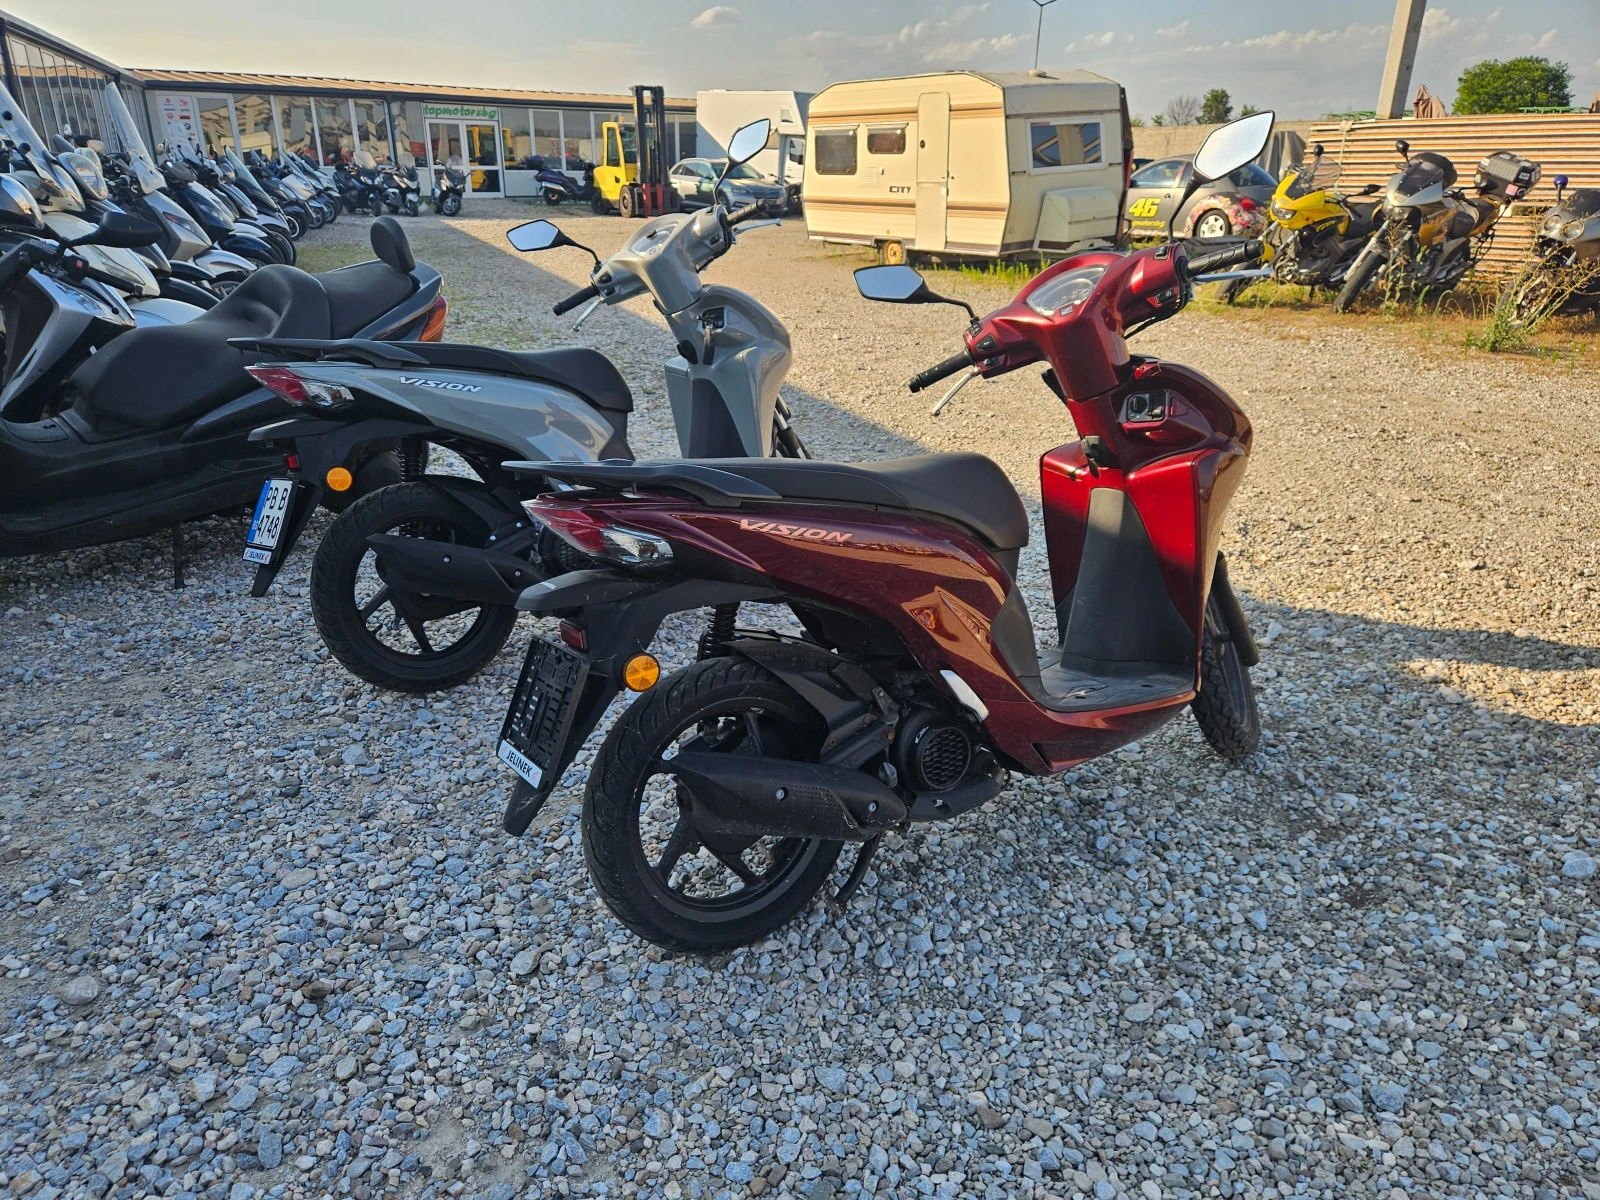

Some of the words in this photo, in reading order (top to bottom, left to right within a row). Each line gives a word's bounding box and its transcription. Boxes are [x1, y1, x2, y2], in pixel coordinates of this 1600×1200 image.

[889, 185, 911, 193] CITY
[1128, 197, 1161, 217] 46
[399, 376, 482, 393] VISION
[264, 486, 279, 510] PB
[278, 487, 289, 511] B
[257, 514, 280, 539] 4748
[740, 519, 853, 542] VISION
[506, 749, 532, 777] JELINEK
